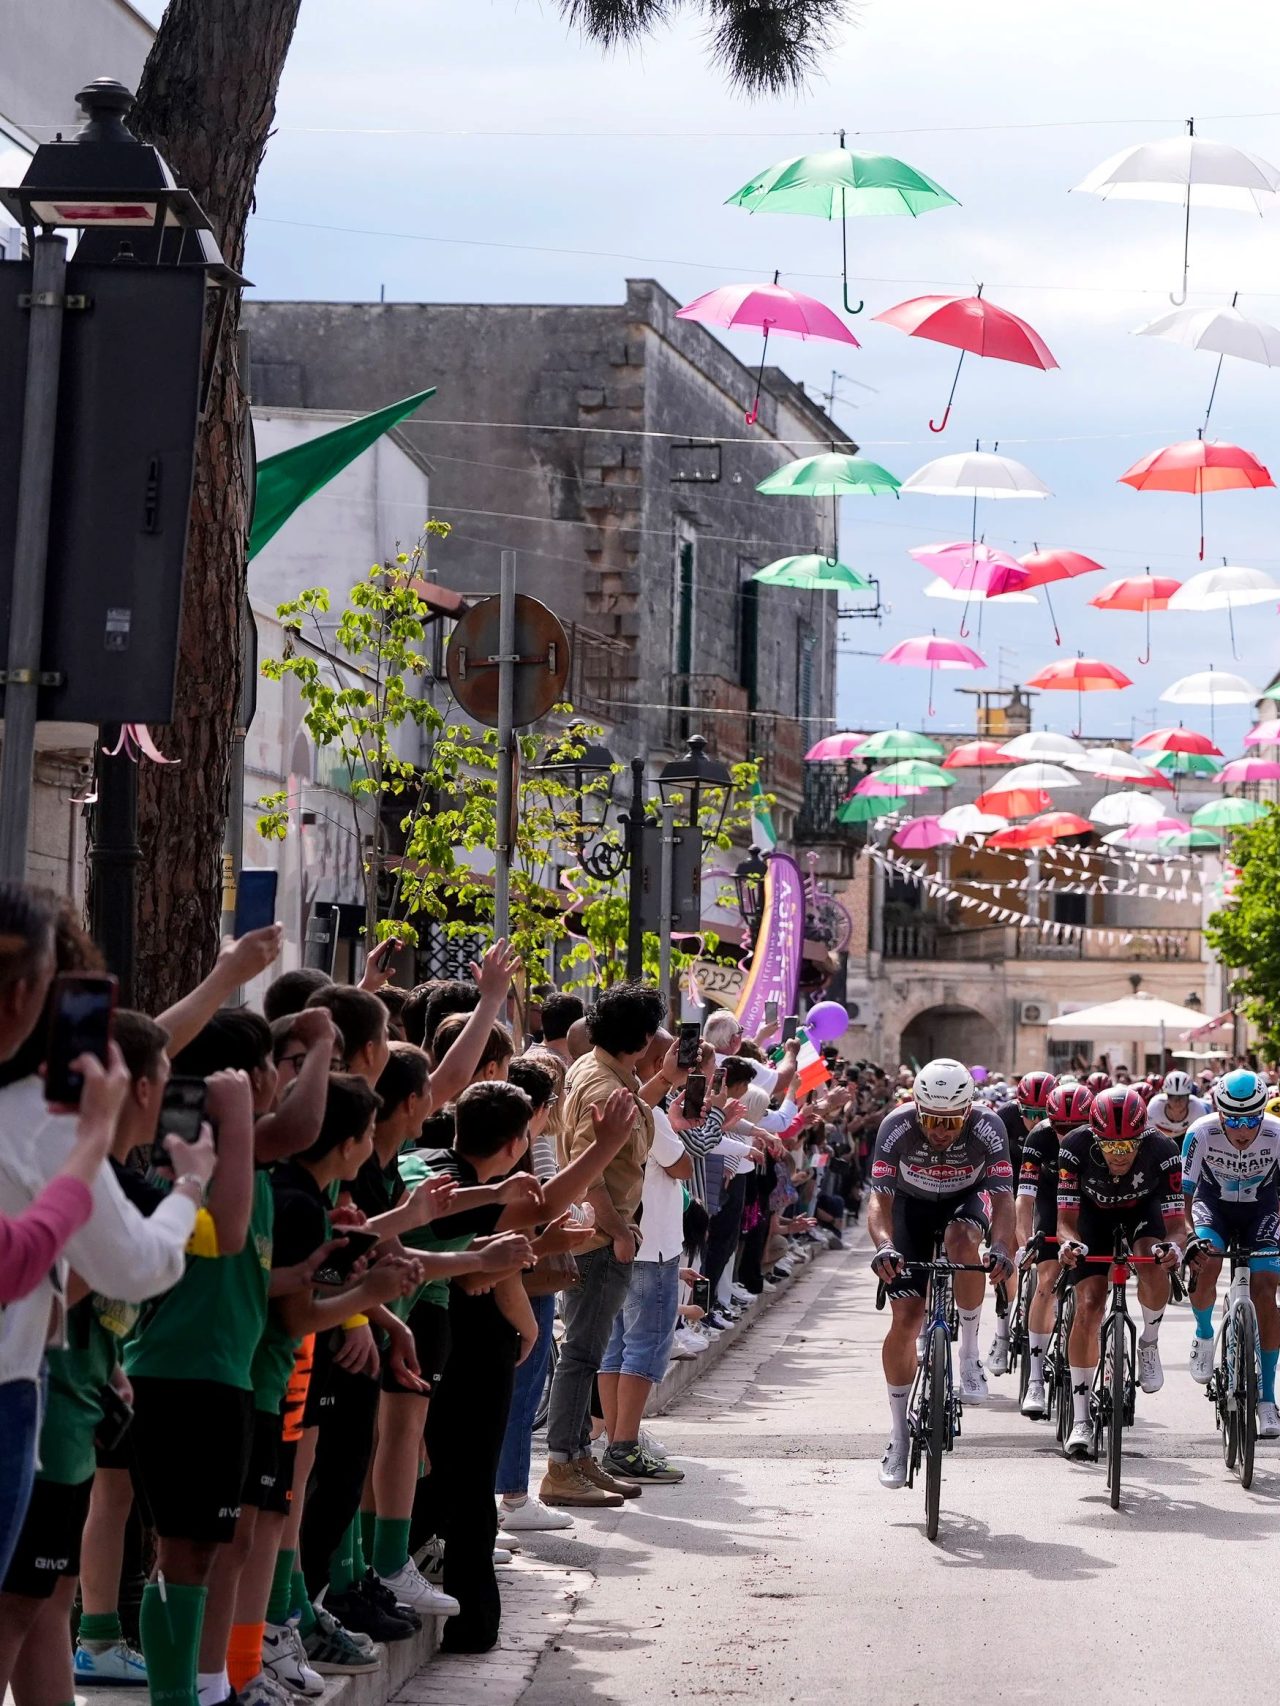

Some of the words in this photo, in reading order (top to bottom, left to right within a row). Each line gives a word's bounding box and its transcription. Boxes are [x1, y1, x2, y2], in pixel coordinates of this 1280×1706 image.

[973, 1118, 1004, 1153] Alpecin
[1058, 1148, 1080, 1165] BMC
[1184, 1137, 1198, 1176] MERIDA
[1206, 1155, 1274, 1169] BAHRAIN
[917, 1168, 967, 1178] Alpecin
[1085, 1186, 1149, 1203] TUDOR
